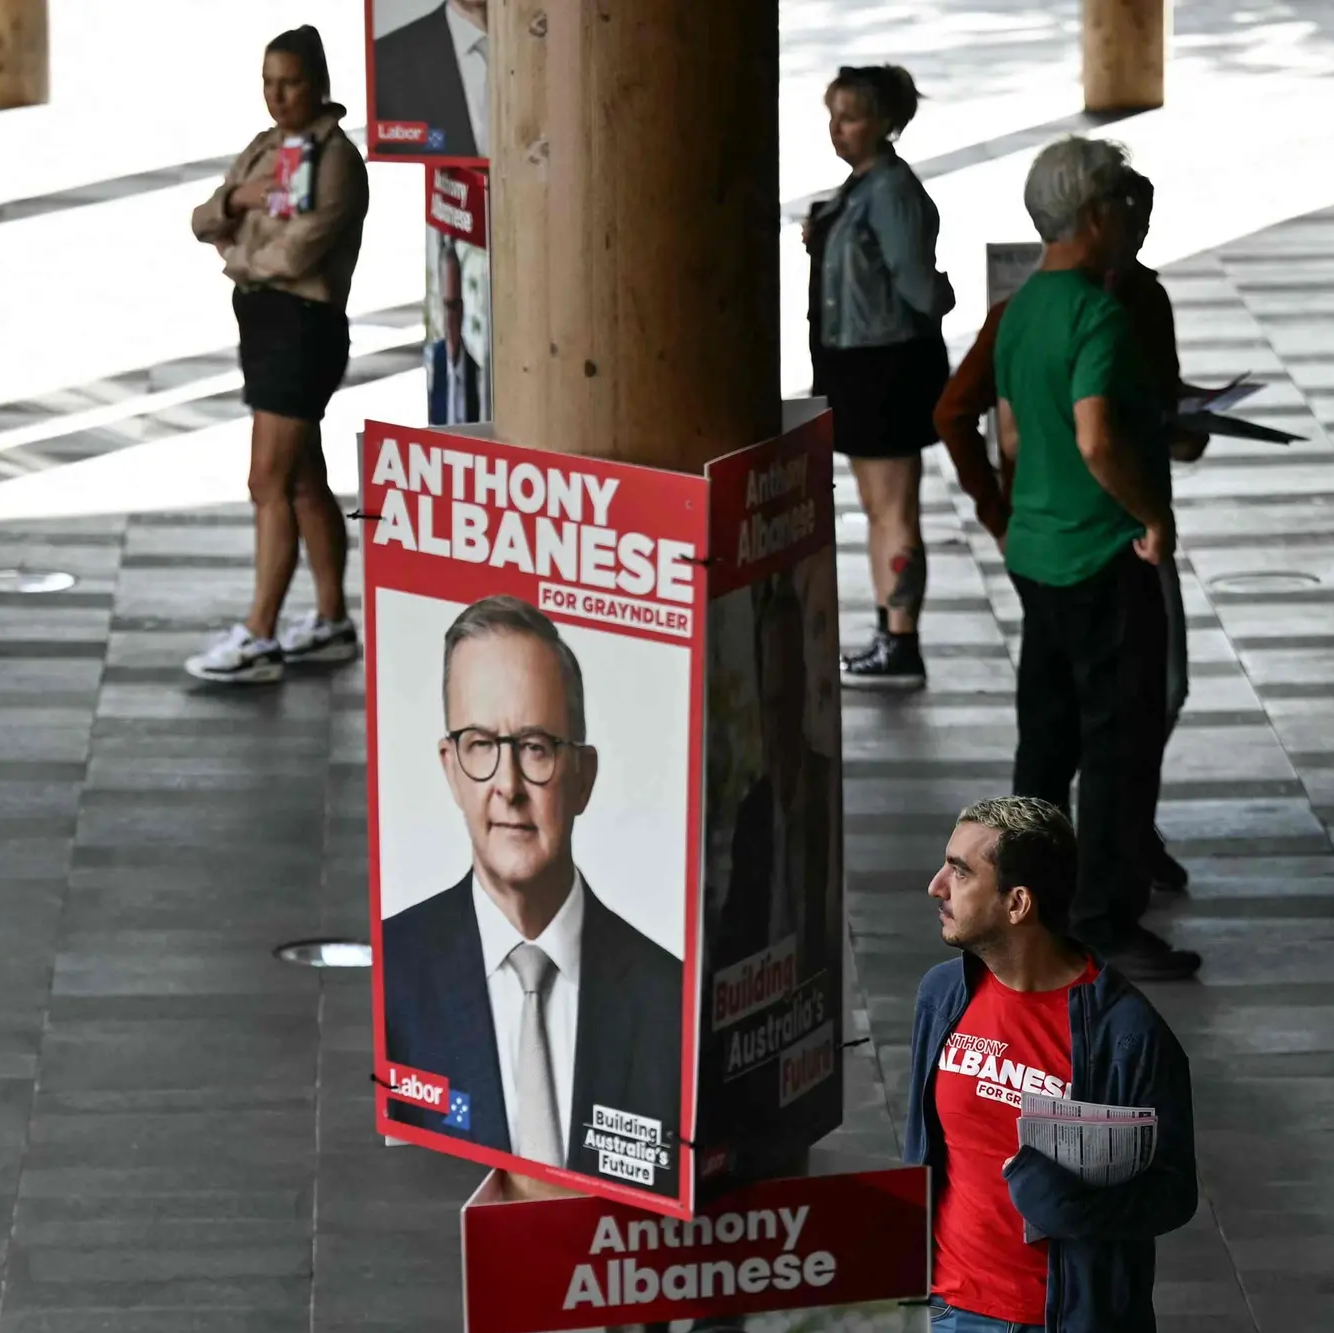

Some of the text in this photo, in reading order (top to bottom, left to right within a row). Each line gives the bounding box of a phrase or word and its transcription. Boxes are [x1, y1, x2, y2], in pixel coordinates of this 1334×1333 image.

[378, 124, 421, 139] Labor
[372, 438, 620, 526] ANTHONY
[373, 490, 694, 604] ALBANESE
[542, 589, 689, 632] FOR GRAYNDLER
[946, 1032, 1008, 1057] NTHONY
[390, 1069, 443, 1105] Labor
[938, 1048, 1071, 1100] ALBANES
[979, 1085, 1002, 1099] FOR
[596, 1111, 658, 1140] Building
[584, 1129, 668, 1165] Australia's
[602, 1155, 650, 1181] Future
[589, 1205, 809, 1255] Anthony
[562, 1250, 836, 1310] Albanese
